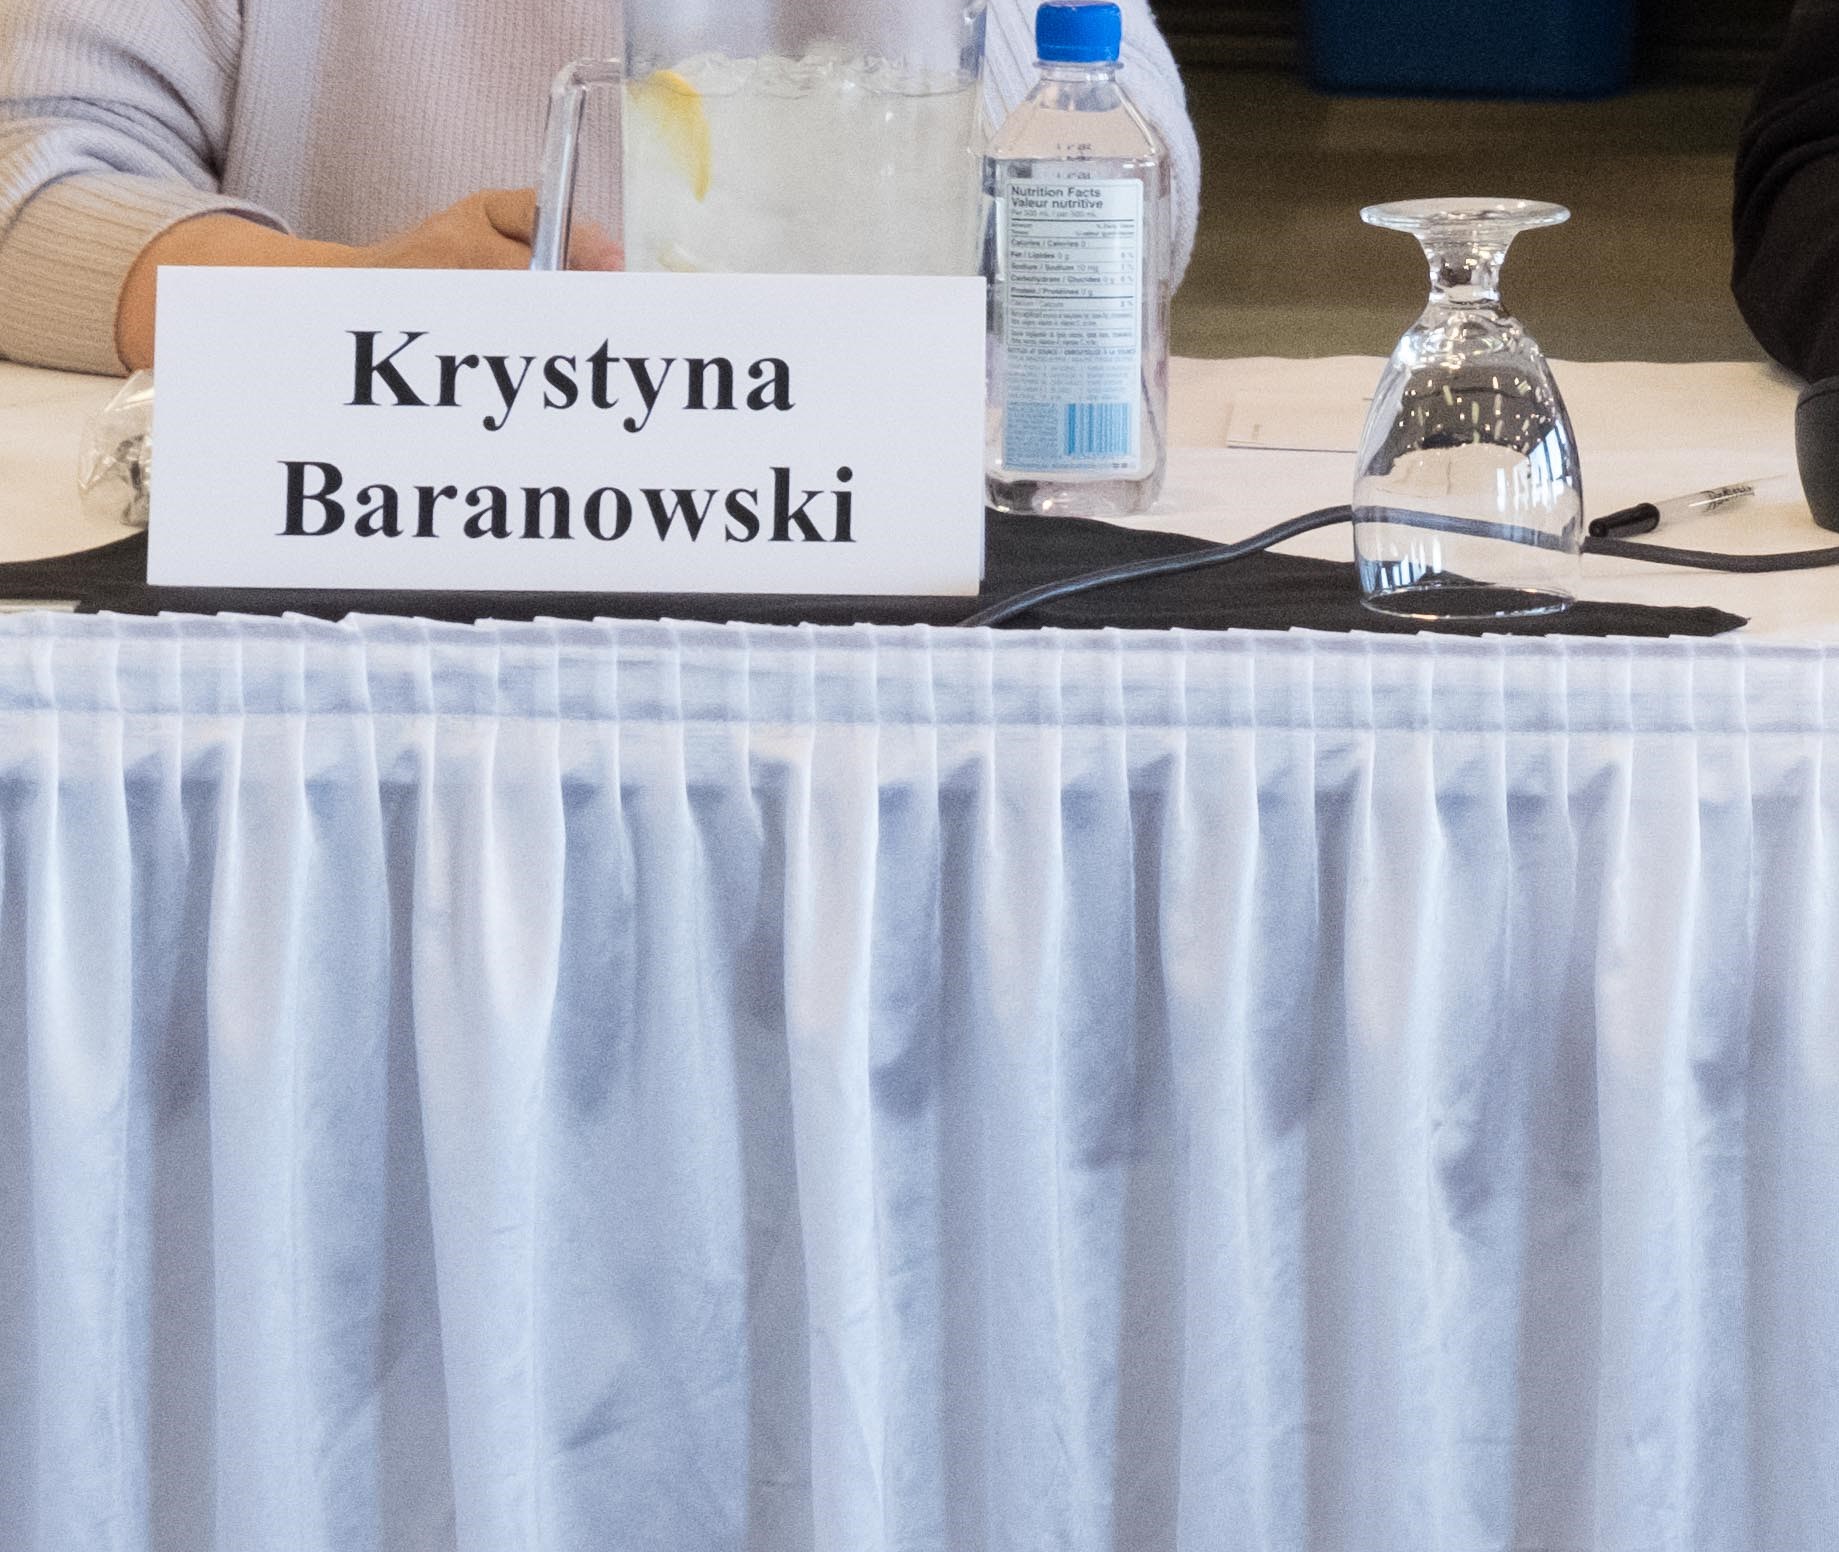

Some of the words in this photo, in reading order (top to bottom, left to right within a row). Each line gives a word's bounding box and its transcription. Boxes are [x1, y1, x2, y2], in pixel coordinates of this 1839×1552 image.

[1011, 186, 1063, 197] Nutrition
[1068, 187, 1101, 197] Facts
[1011, 197, 1047, 208] Valeur
[1052, 198, 1103, 208] nutritive
[345, 331, 795, 433] Krystyna
[276, 461, 856, 542] Baranowski
